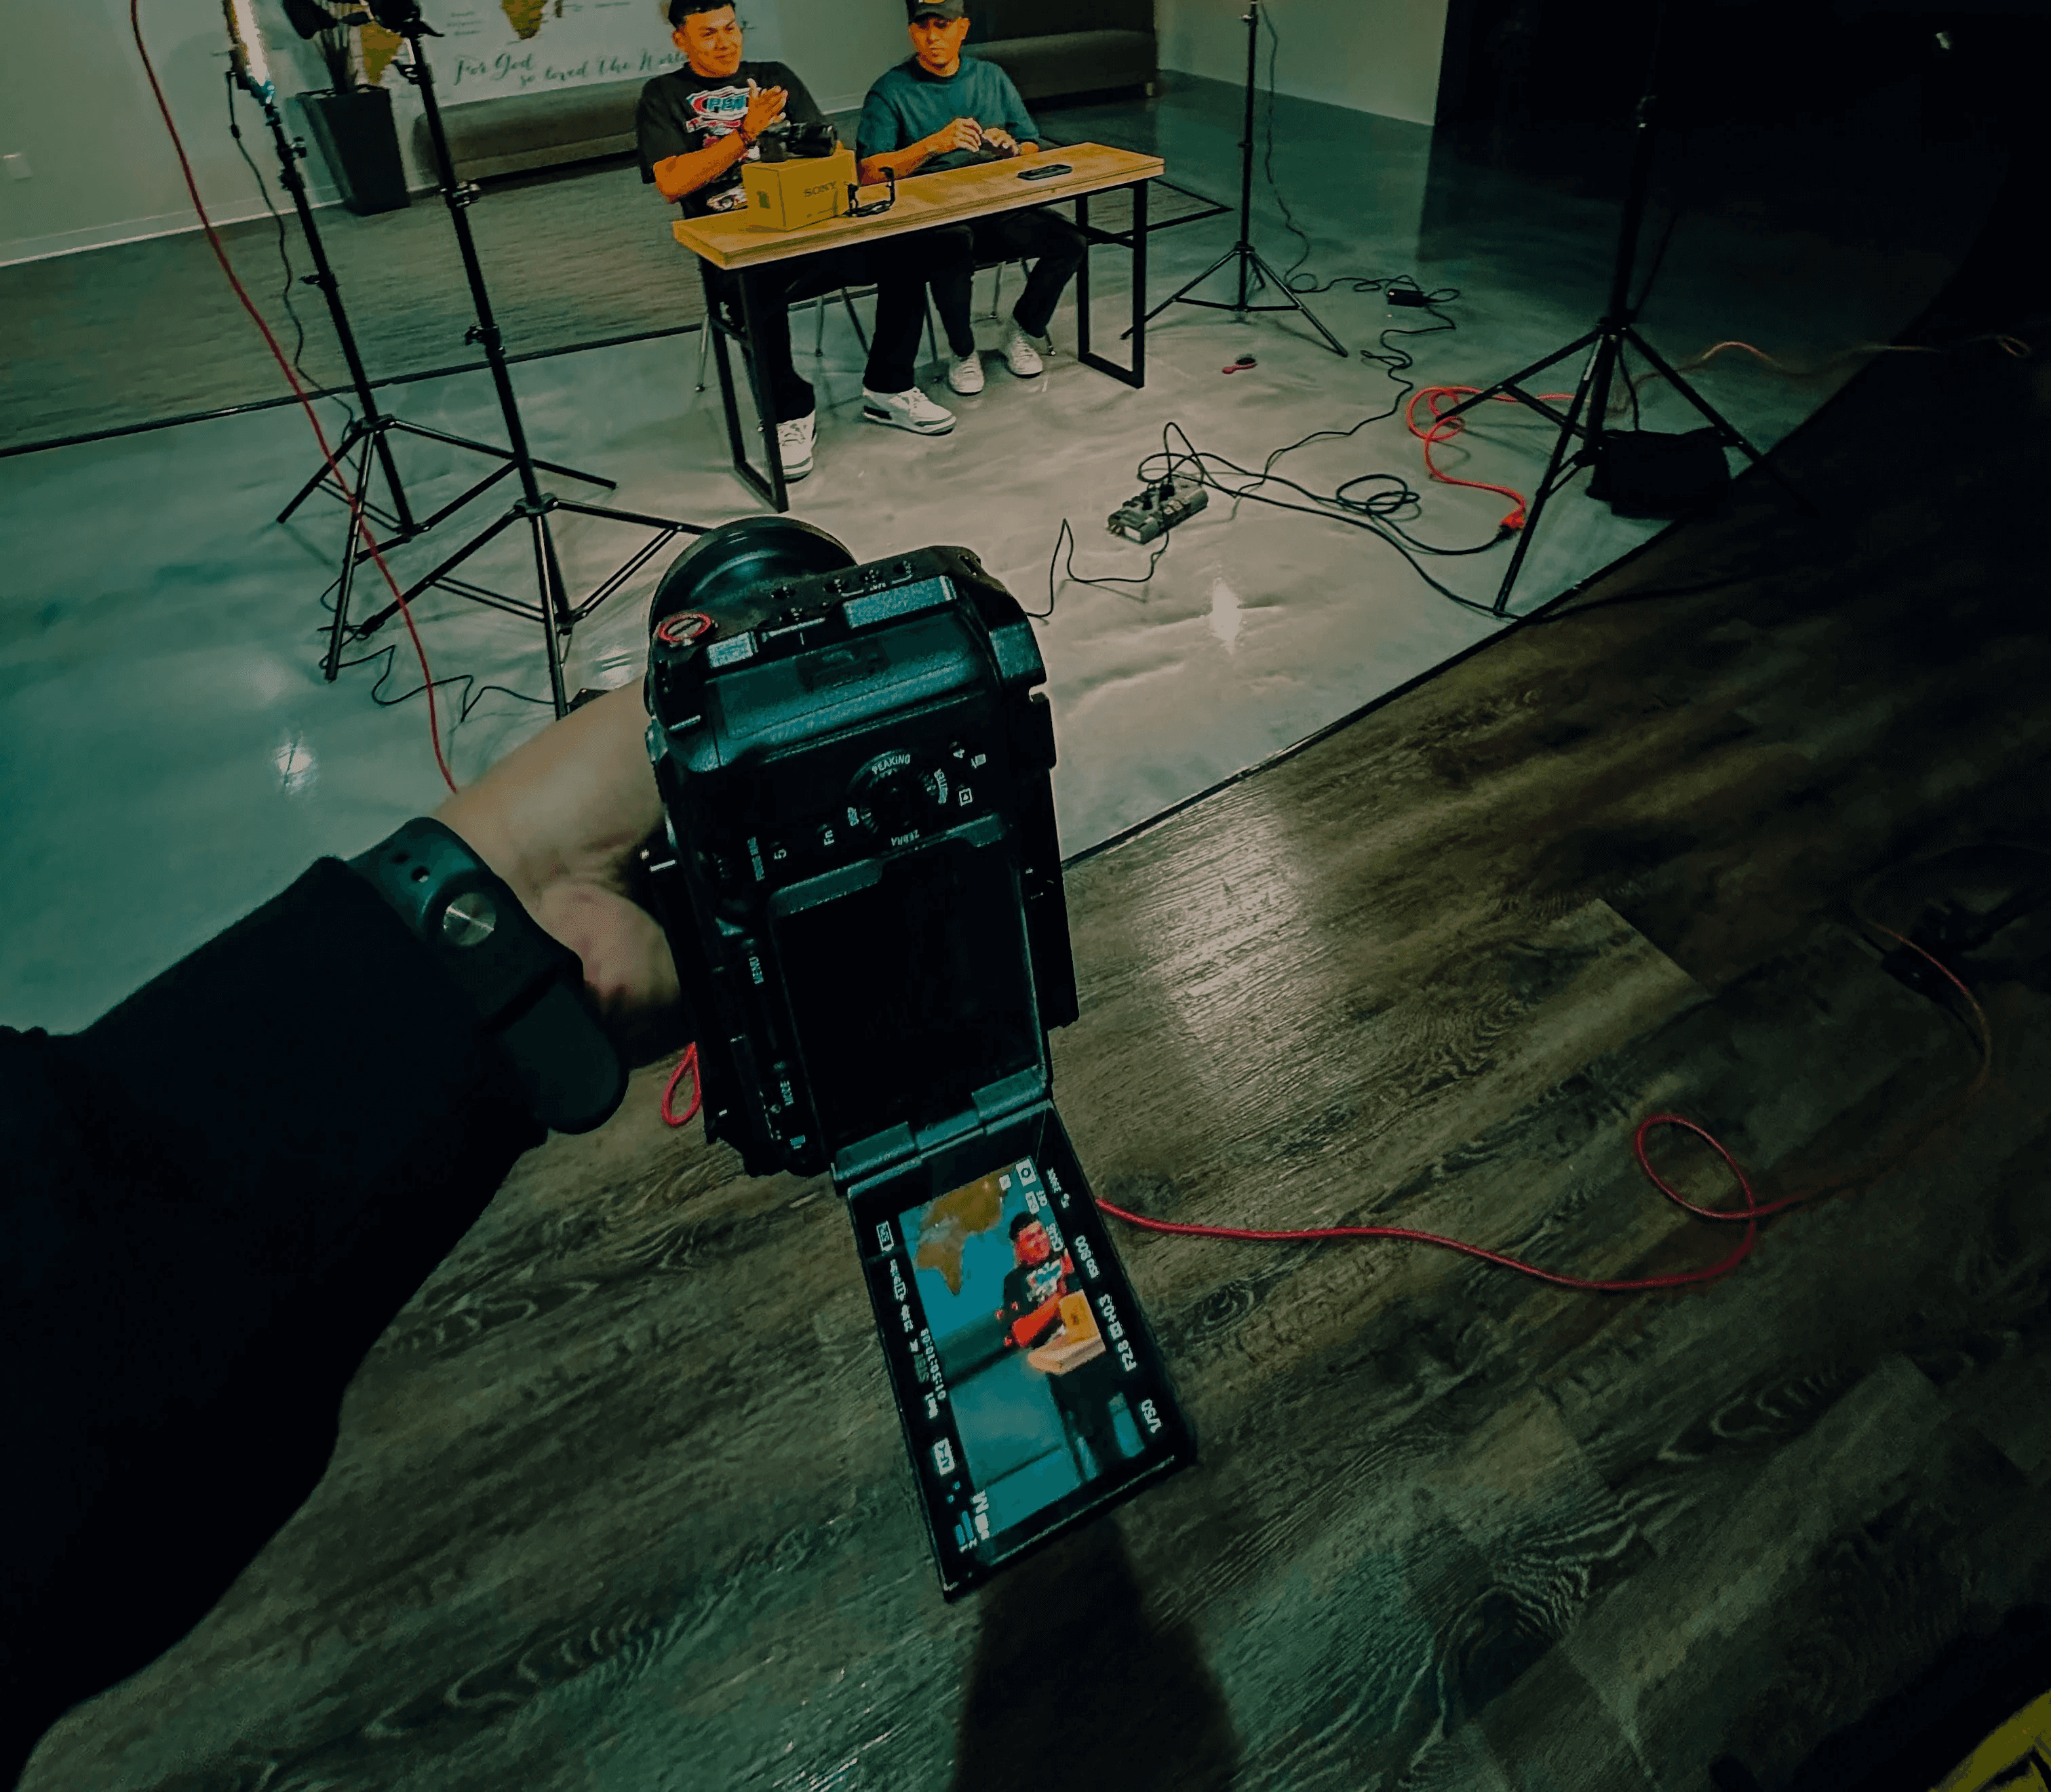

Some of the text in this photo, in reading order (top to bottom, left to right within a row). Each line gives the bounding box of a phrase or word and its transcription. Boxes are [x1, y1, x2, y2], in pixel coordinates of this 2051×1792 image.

[489, 52, 536, 81] God
[803, 180, 837, 198] SONY
[872, 754, 911, 775] PEAKING
[823, 830, 835, 846] Fn
[773, 849, 787, 860] 5
[1074, 1234, 1092, 1262] 800
[1141, 1399, 1163, 1434] 1/50
